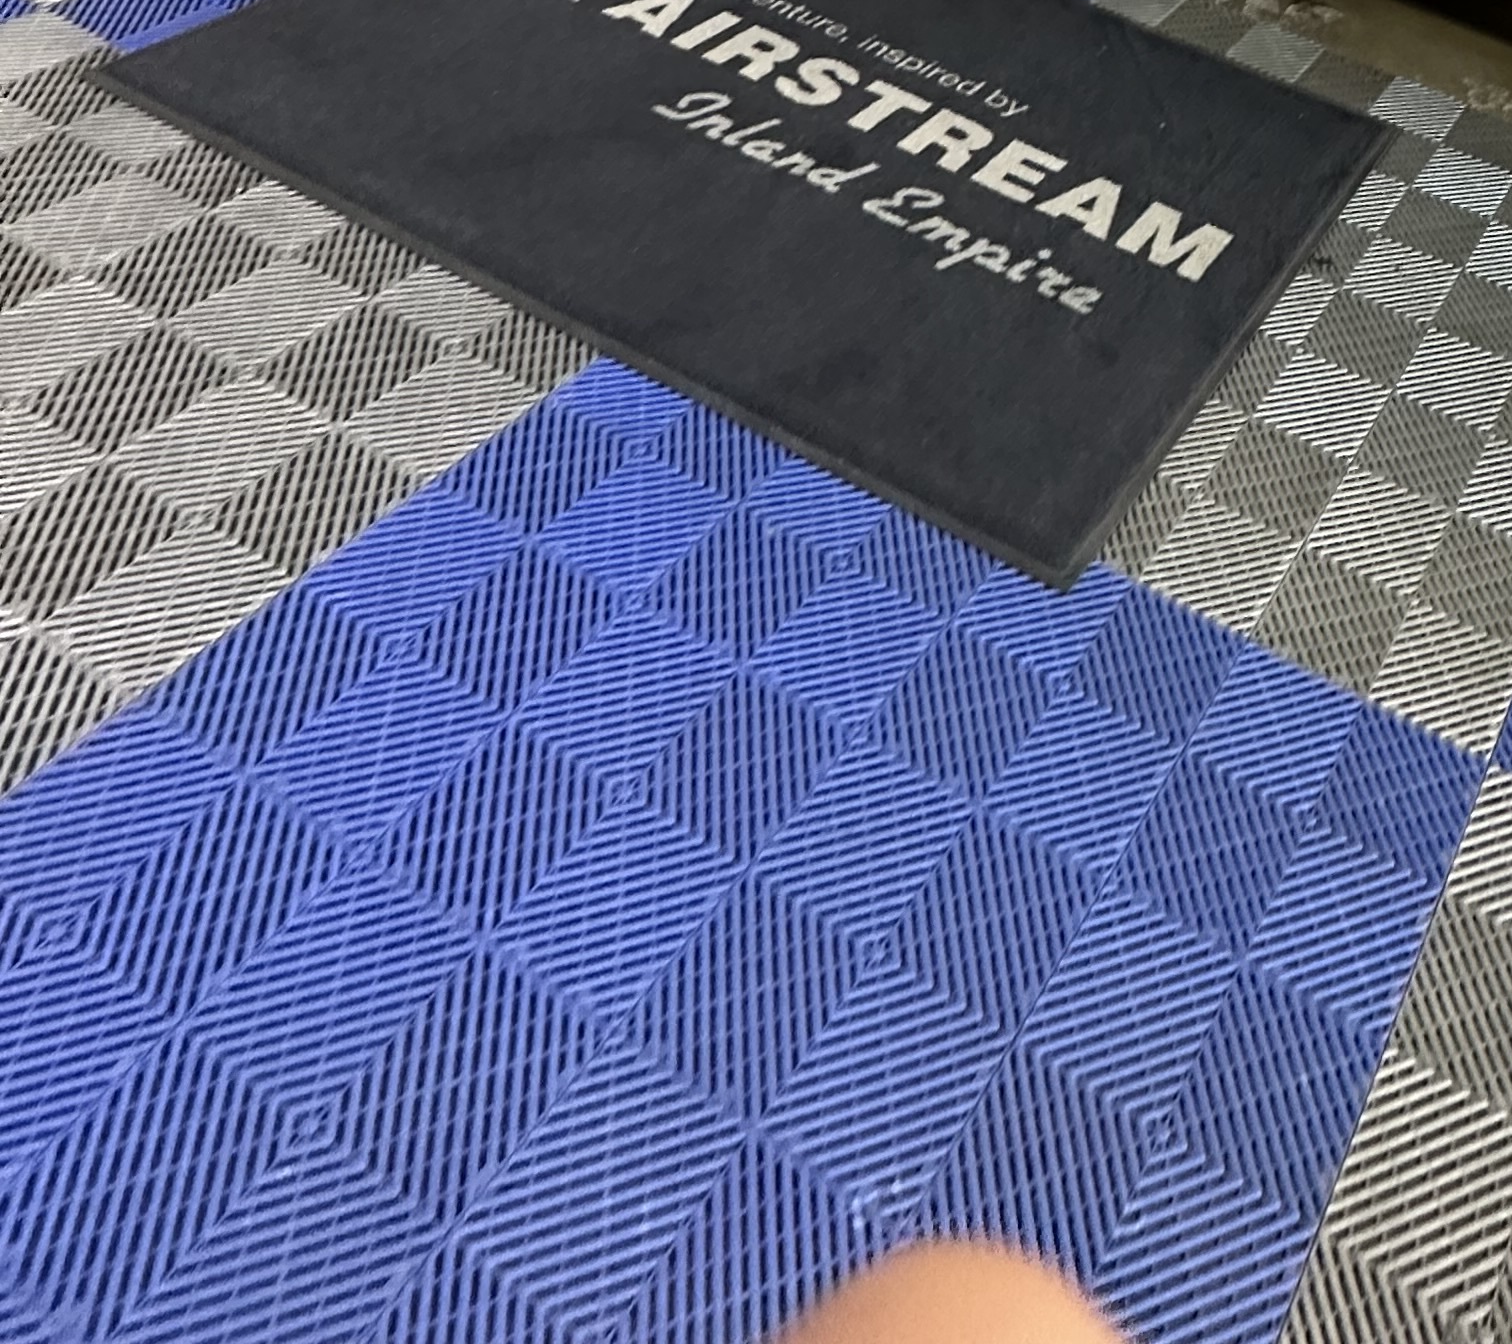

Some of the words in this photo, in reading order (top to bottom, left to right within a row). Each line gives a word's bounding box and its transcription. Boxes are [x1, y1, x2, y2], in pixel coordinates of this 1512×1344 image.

[857, 26, 986, 98] inspired
[985, 82, 1030, 118] by
[651, 90, 876, 196] Inland
[862, 186, 1106, 316] Empire
